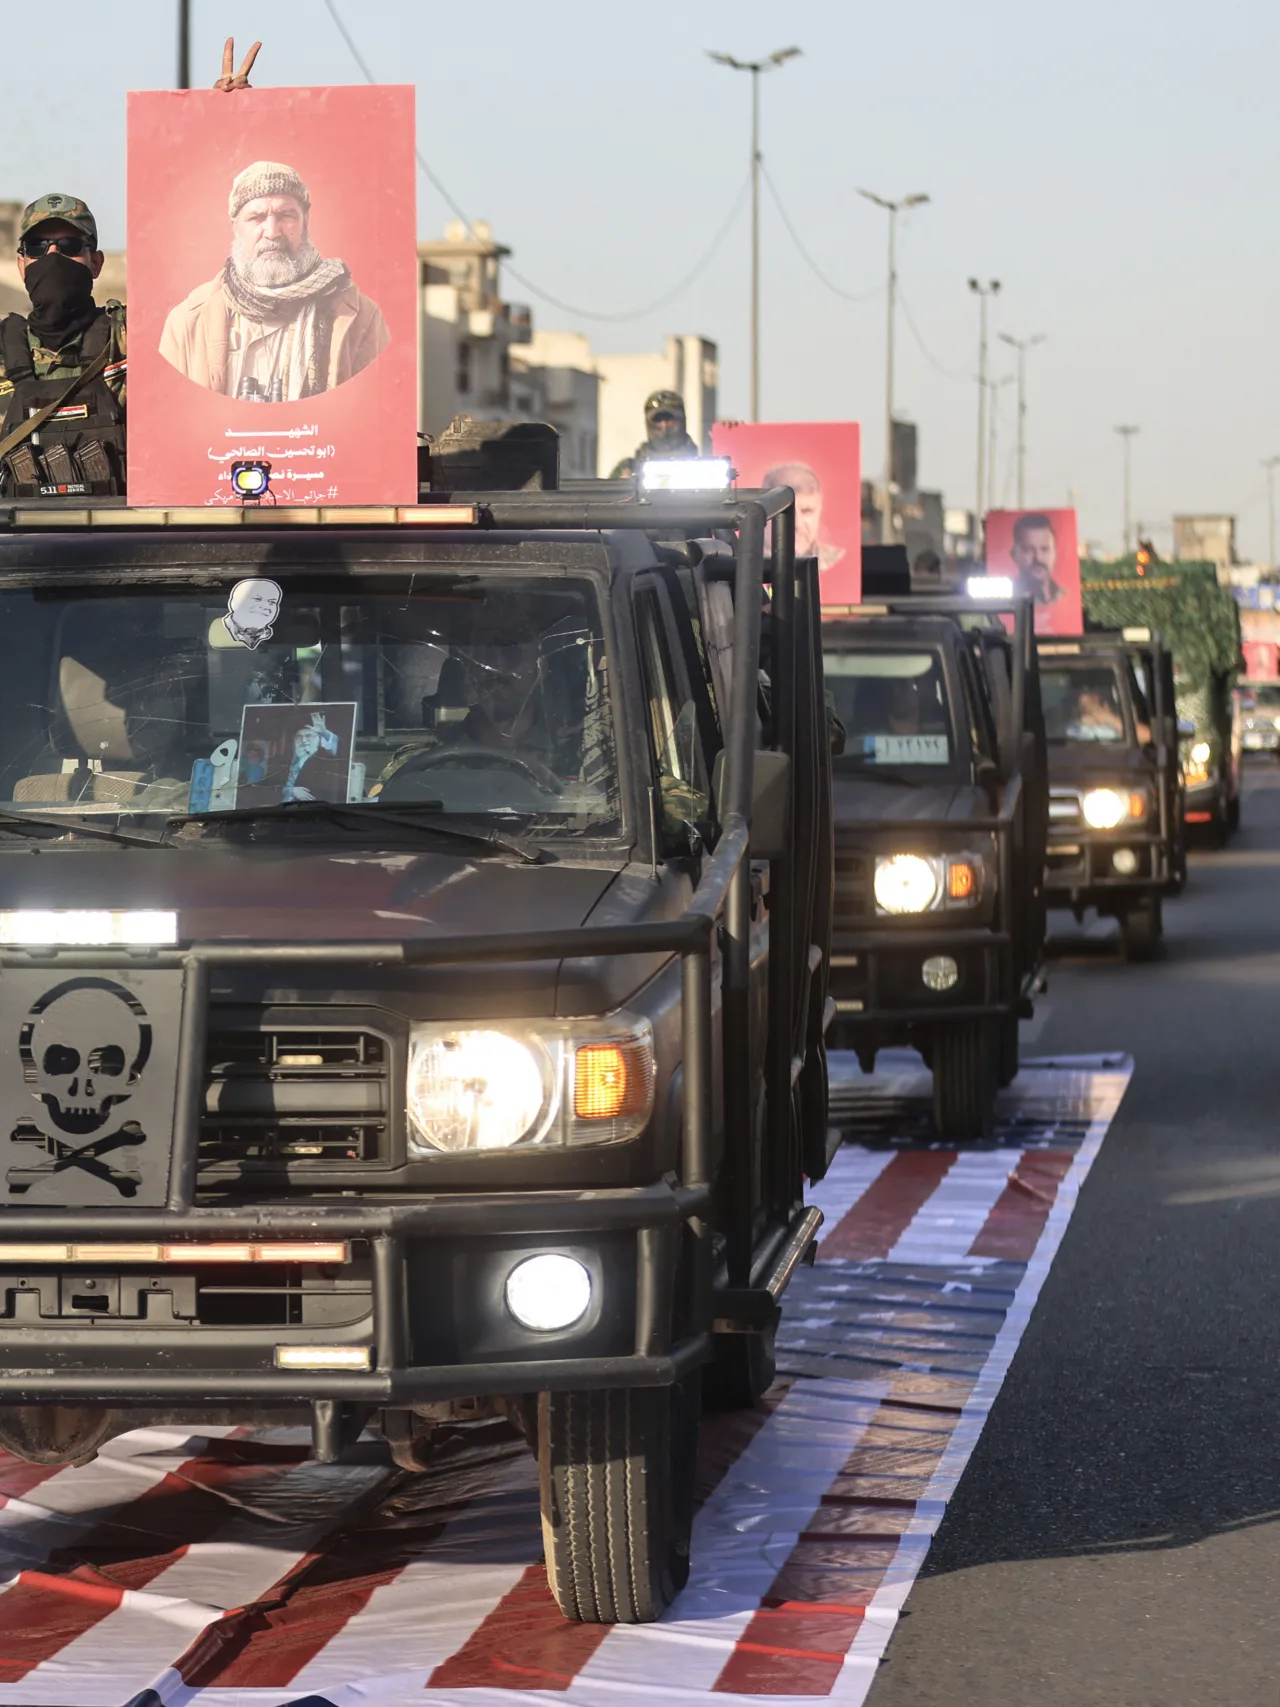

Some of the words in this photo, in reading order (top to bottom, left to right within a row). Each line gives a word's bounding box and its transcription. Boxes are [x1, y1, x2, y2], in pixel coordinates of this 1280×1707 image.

[224, 424, 319, 439] الشهيد
[268, 468, 285, 480] نص
[286, 469, 325, 481] مسيرة
[40, 486, 58, 495] 5.11
